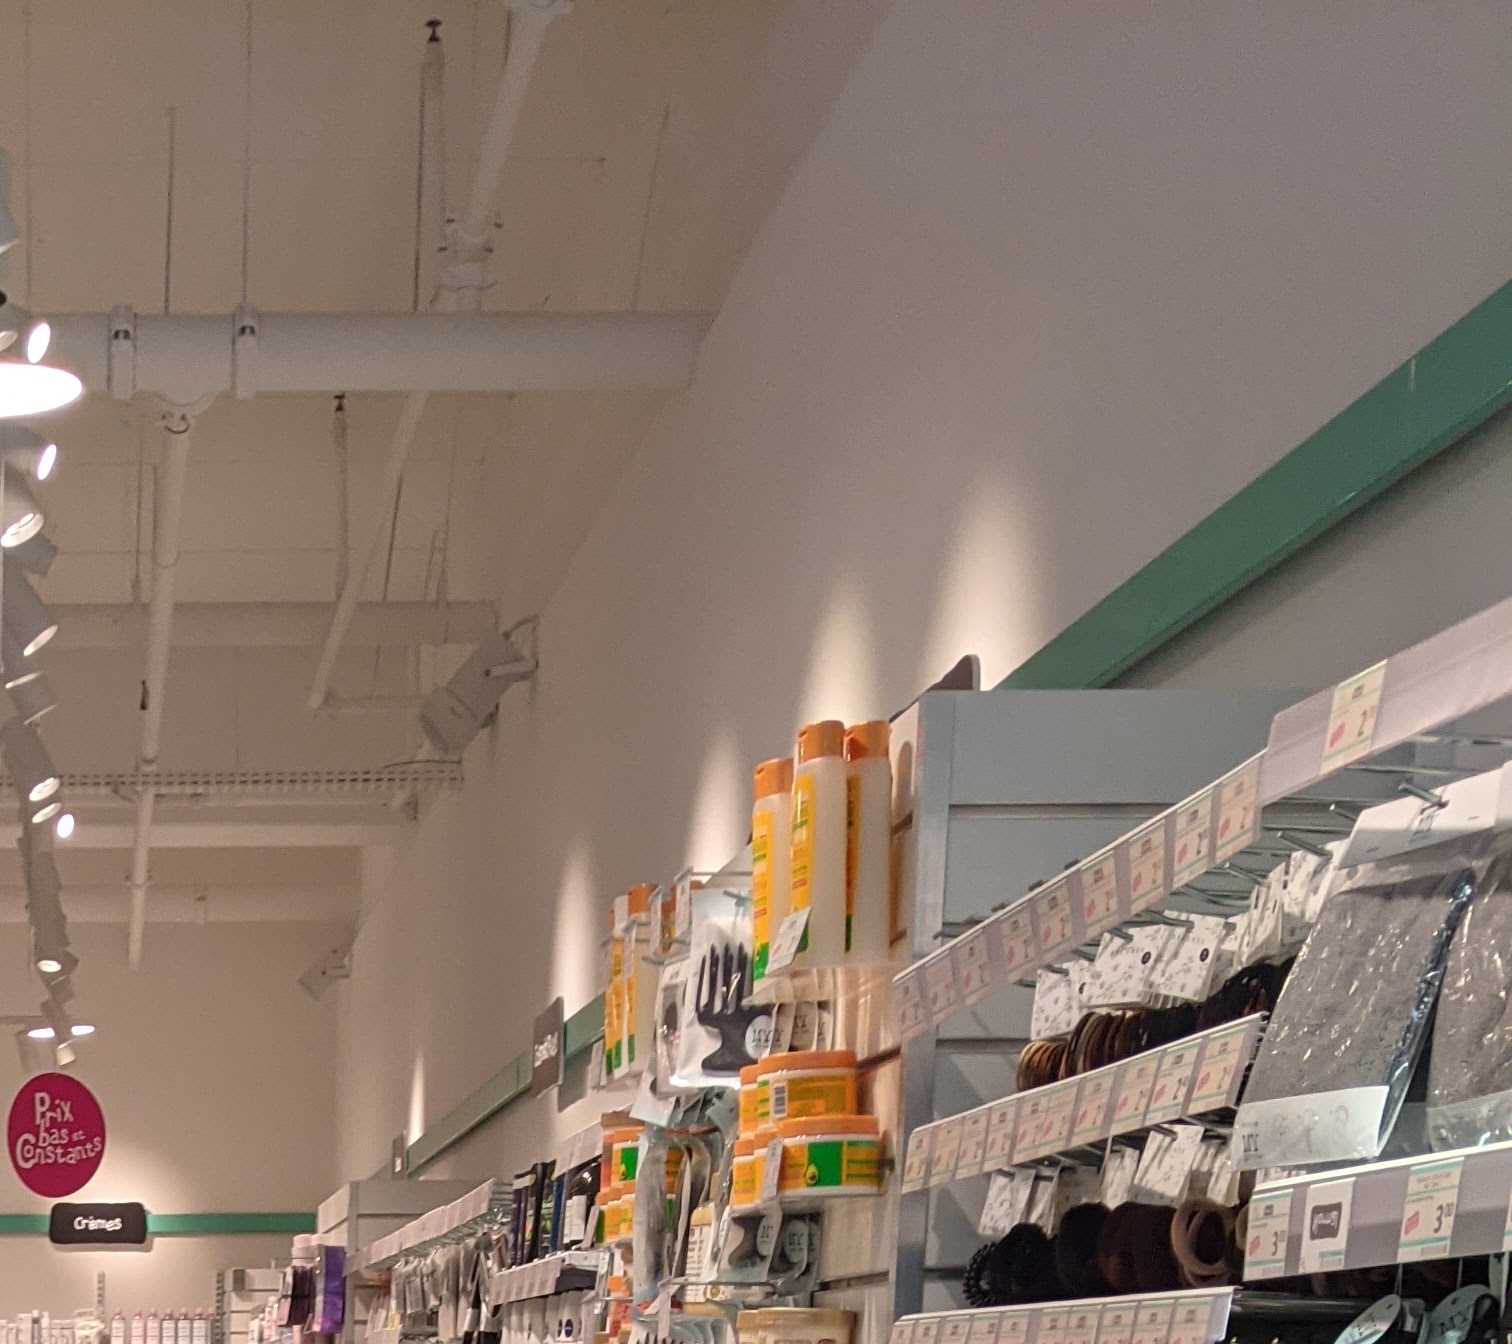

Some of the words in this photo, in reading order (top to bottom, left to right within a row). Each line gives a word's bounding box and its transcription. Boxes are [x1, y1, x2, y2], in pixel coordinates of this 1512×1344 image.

[34, 1092, 74, 1127] Prix
[38, 1119, 69, 1146] bas
[16, 1132, 102, 1169] Constants
